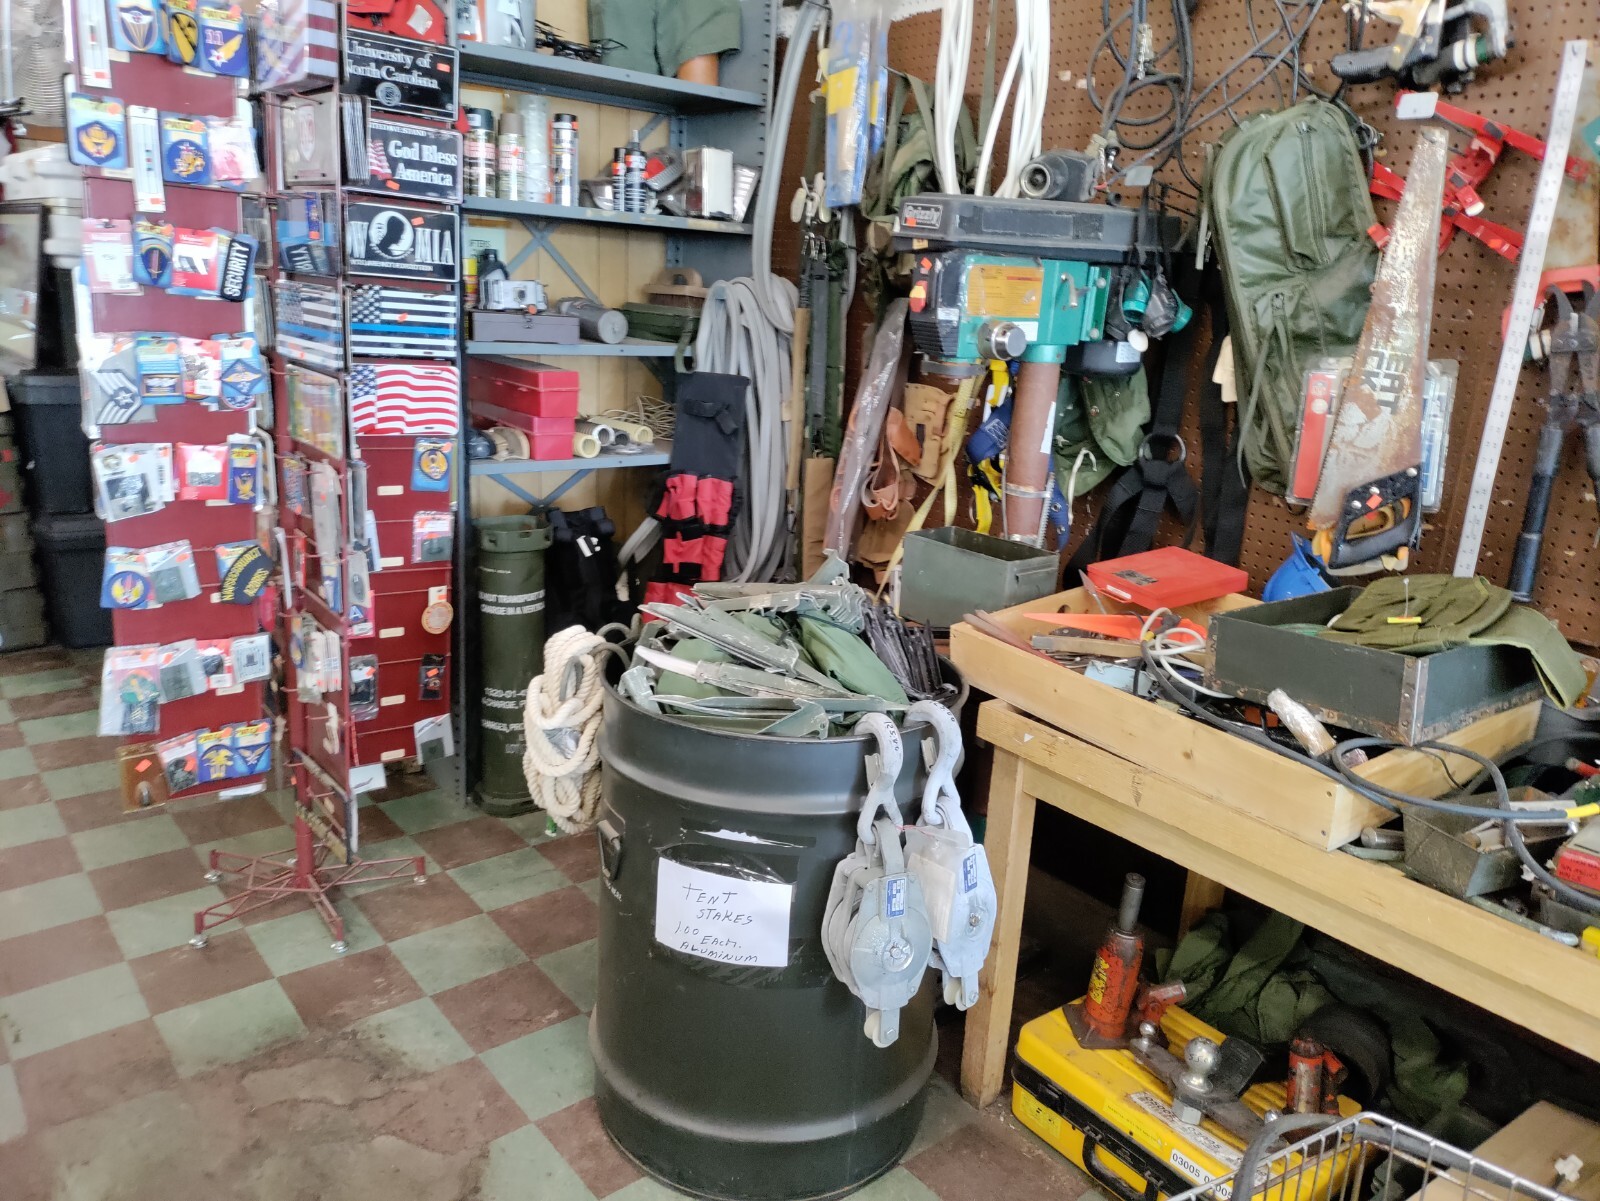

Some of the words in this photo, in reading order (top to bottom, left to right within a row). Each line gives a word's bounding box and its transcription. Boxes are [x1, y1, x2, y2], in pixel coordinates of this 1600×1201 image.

[346, 39, 414, 69] University
[416, 53, 434, 69] of
[346, 58, 381, 79] North
[380, 65, 441, 90] Carolina
[388, 140, 420, 161] God
[420, 144, 458, 167] Bless
[393, 162, 454, 187] America
[414, 227, 455, 266] MIA
[223, 242, 250, 297] SECURITY
[682, 883, 738, 904] TENT
[696, 908, 753, 926] STAKES
[680, 941, 758, 963] ALUMINUM
[1172, 1152, 1201, 1179] 03005
